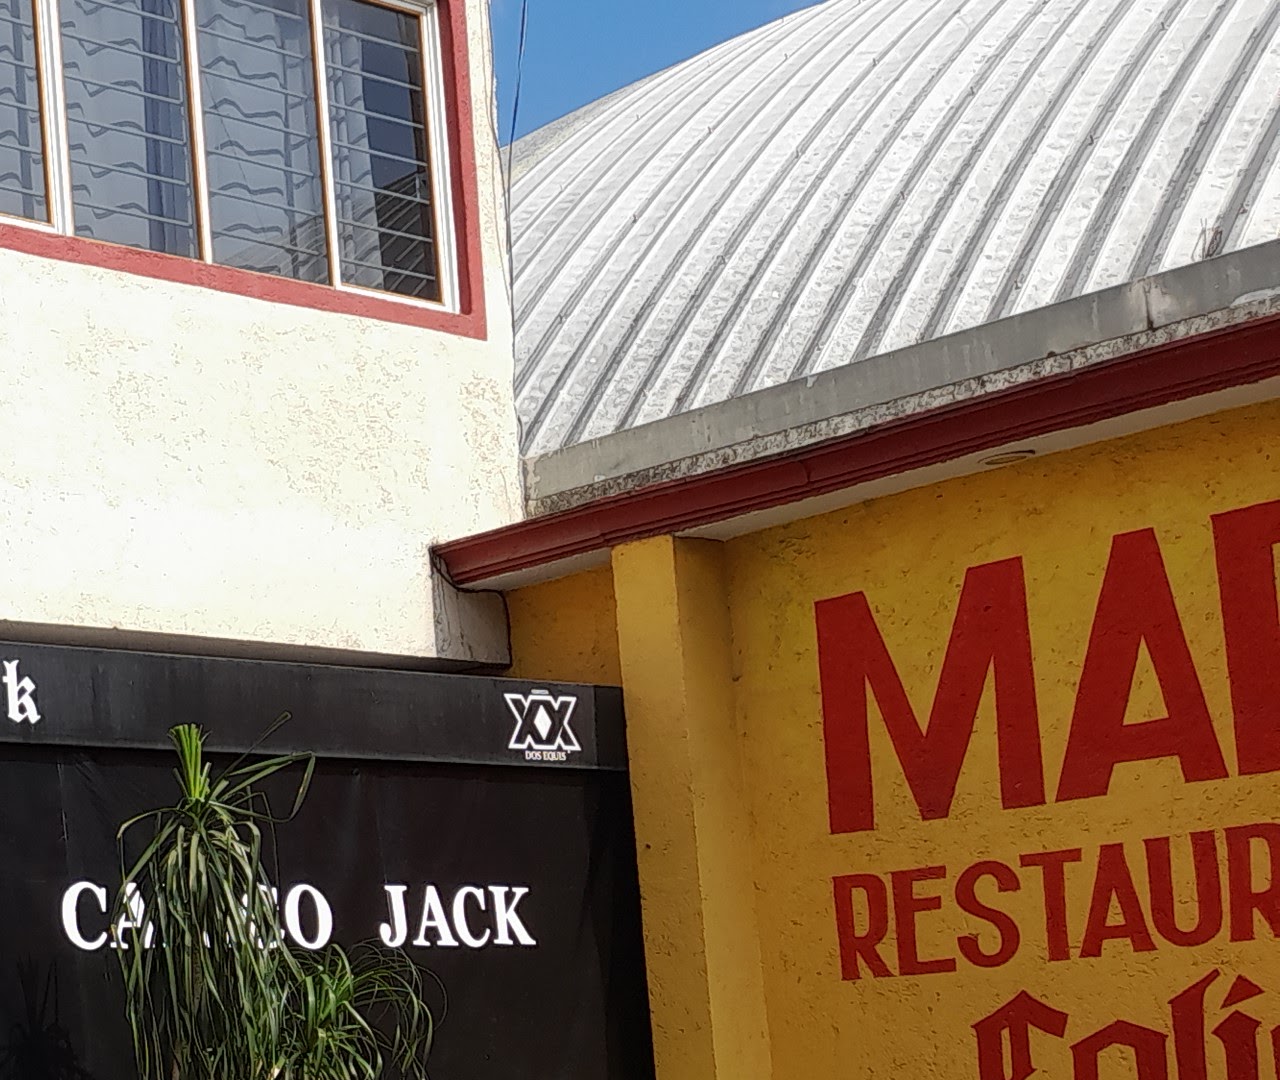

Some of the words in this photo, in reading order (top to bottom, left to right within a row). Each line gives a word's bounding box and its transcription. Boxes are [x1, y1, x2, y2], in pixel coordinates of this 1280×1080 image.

[524, 750, 542, 761] DOS
[542, 751, 567, 762] EQUIS
[379, 884, 537, 948] JACK
[833, 822, 1280, 981] RESTAUR
